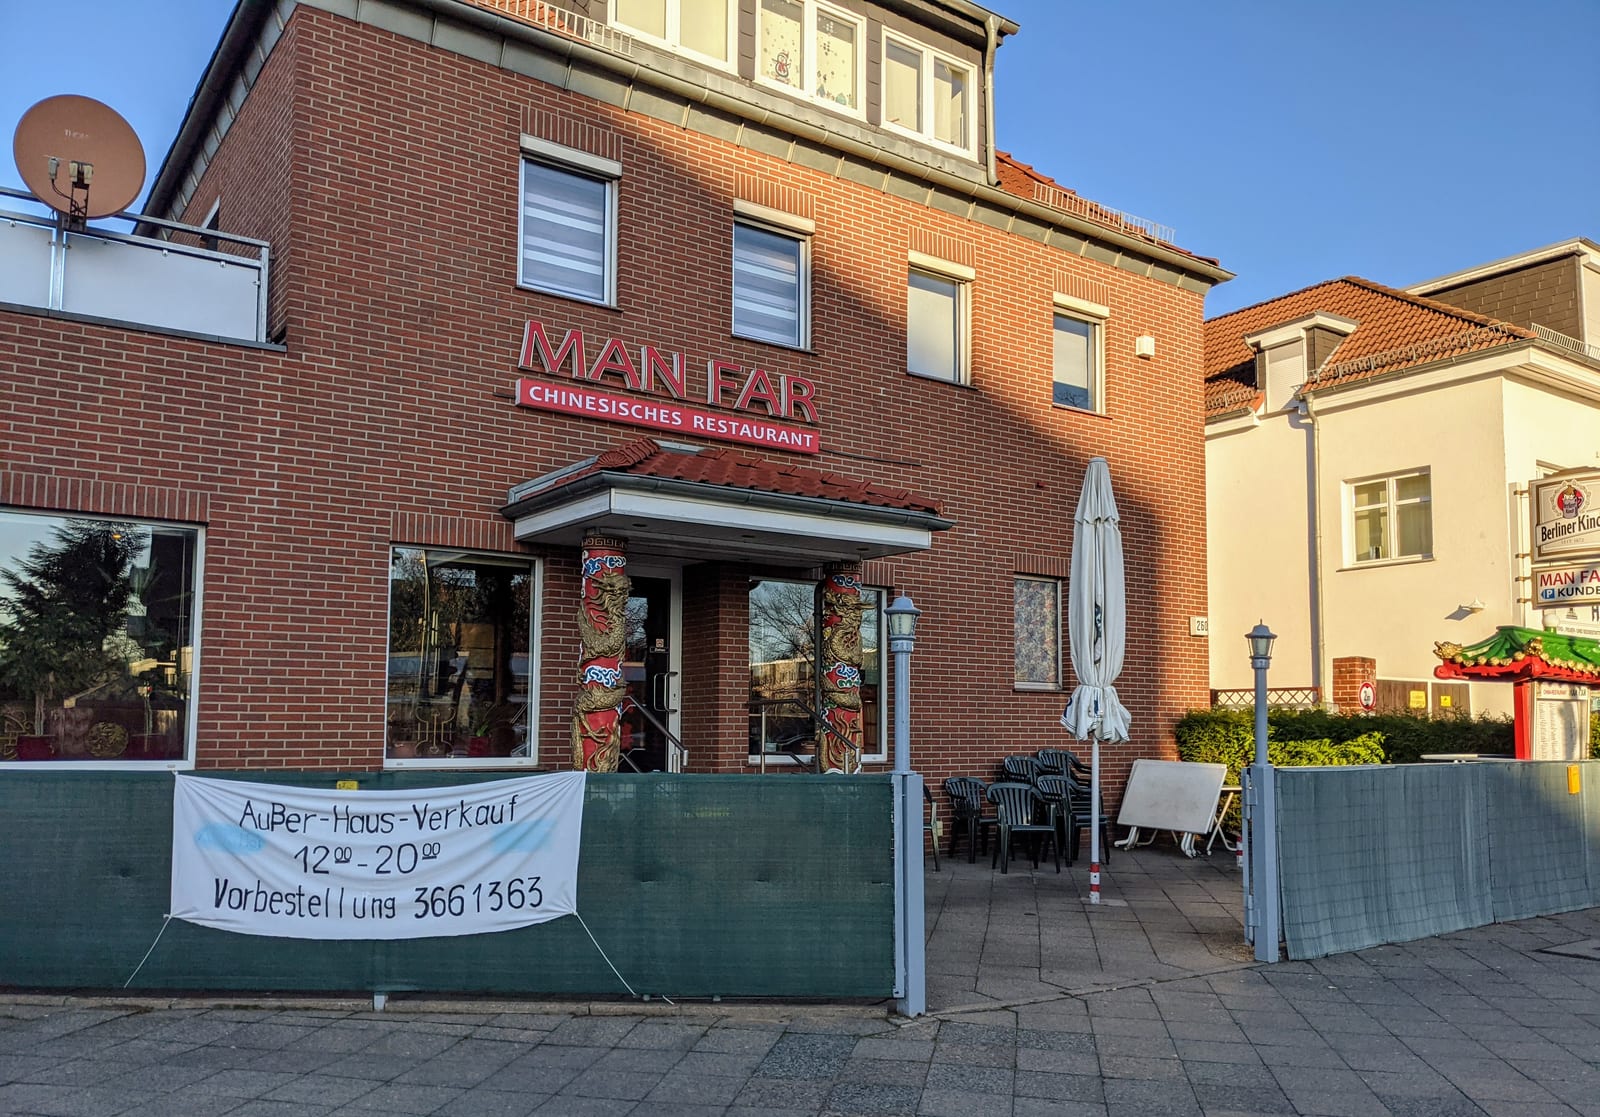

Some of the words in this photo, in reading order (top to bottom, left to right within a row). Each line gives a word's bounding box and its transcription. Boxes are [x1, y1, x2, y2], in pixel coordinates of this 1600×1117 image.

[518, 319, 687, 400] MAN
[707, 358, 819, 423] FAR
[528, 385, 683, 426] CHINESISCHES
[693, 415, 814, 449] RESTAURANT
[1541, 521, 1577, 542] Berliner
[1540, 571, 1575, 587] MAN
[214, 878, 396, 919] Vorbestellung
